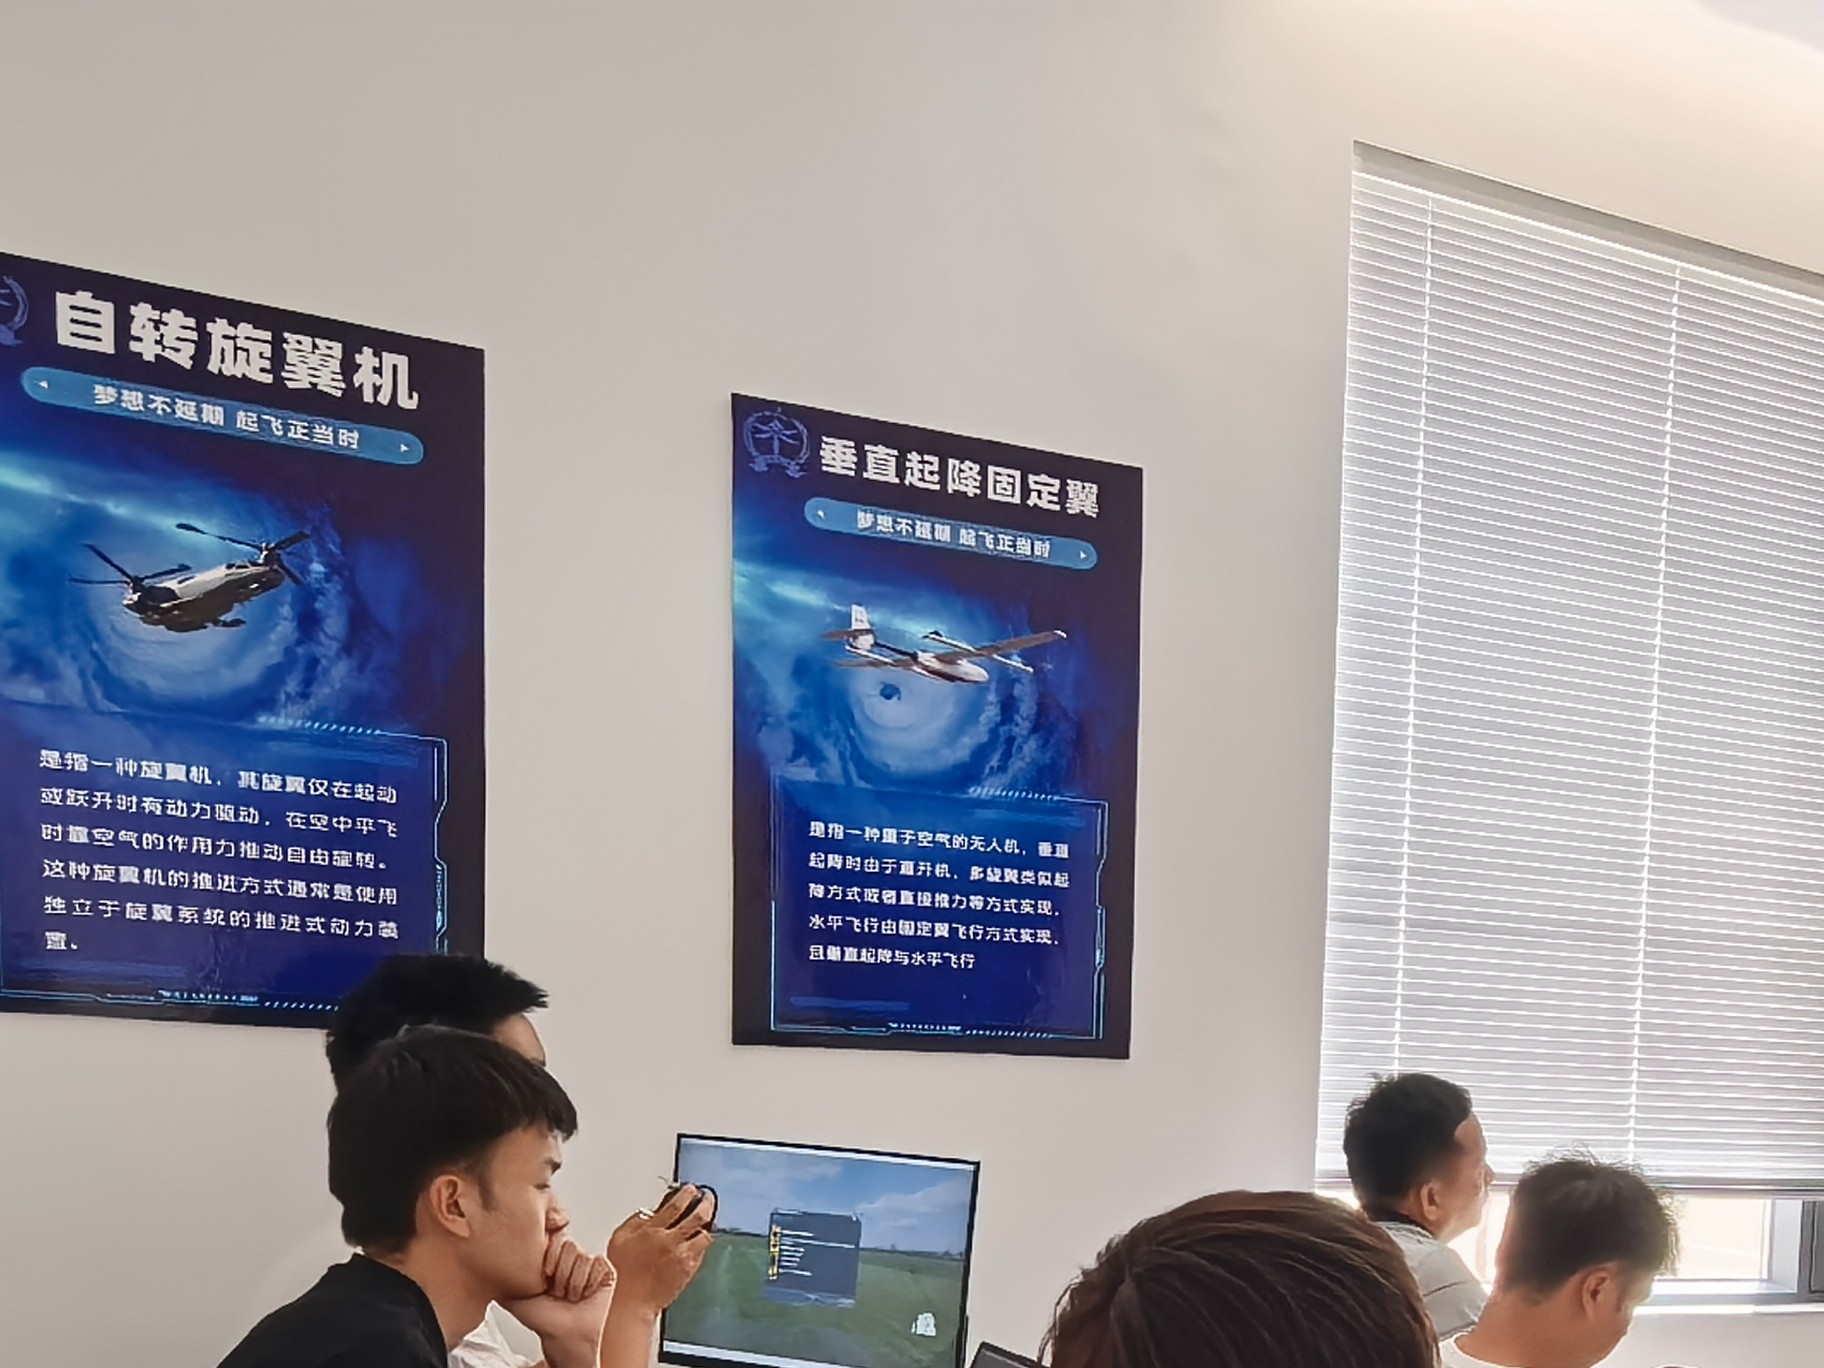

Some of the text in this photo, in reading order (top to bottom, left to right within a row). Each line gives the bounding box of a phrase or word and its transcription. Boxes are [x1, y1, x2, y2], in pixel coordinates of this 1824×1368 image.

[55, 290, 419, 410] 自转旋翼机
[93, 384, 360, 450] 梦想不延期 起飞正当时
[819, 435, 1100, 519] 垂直起降固定翼
